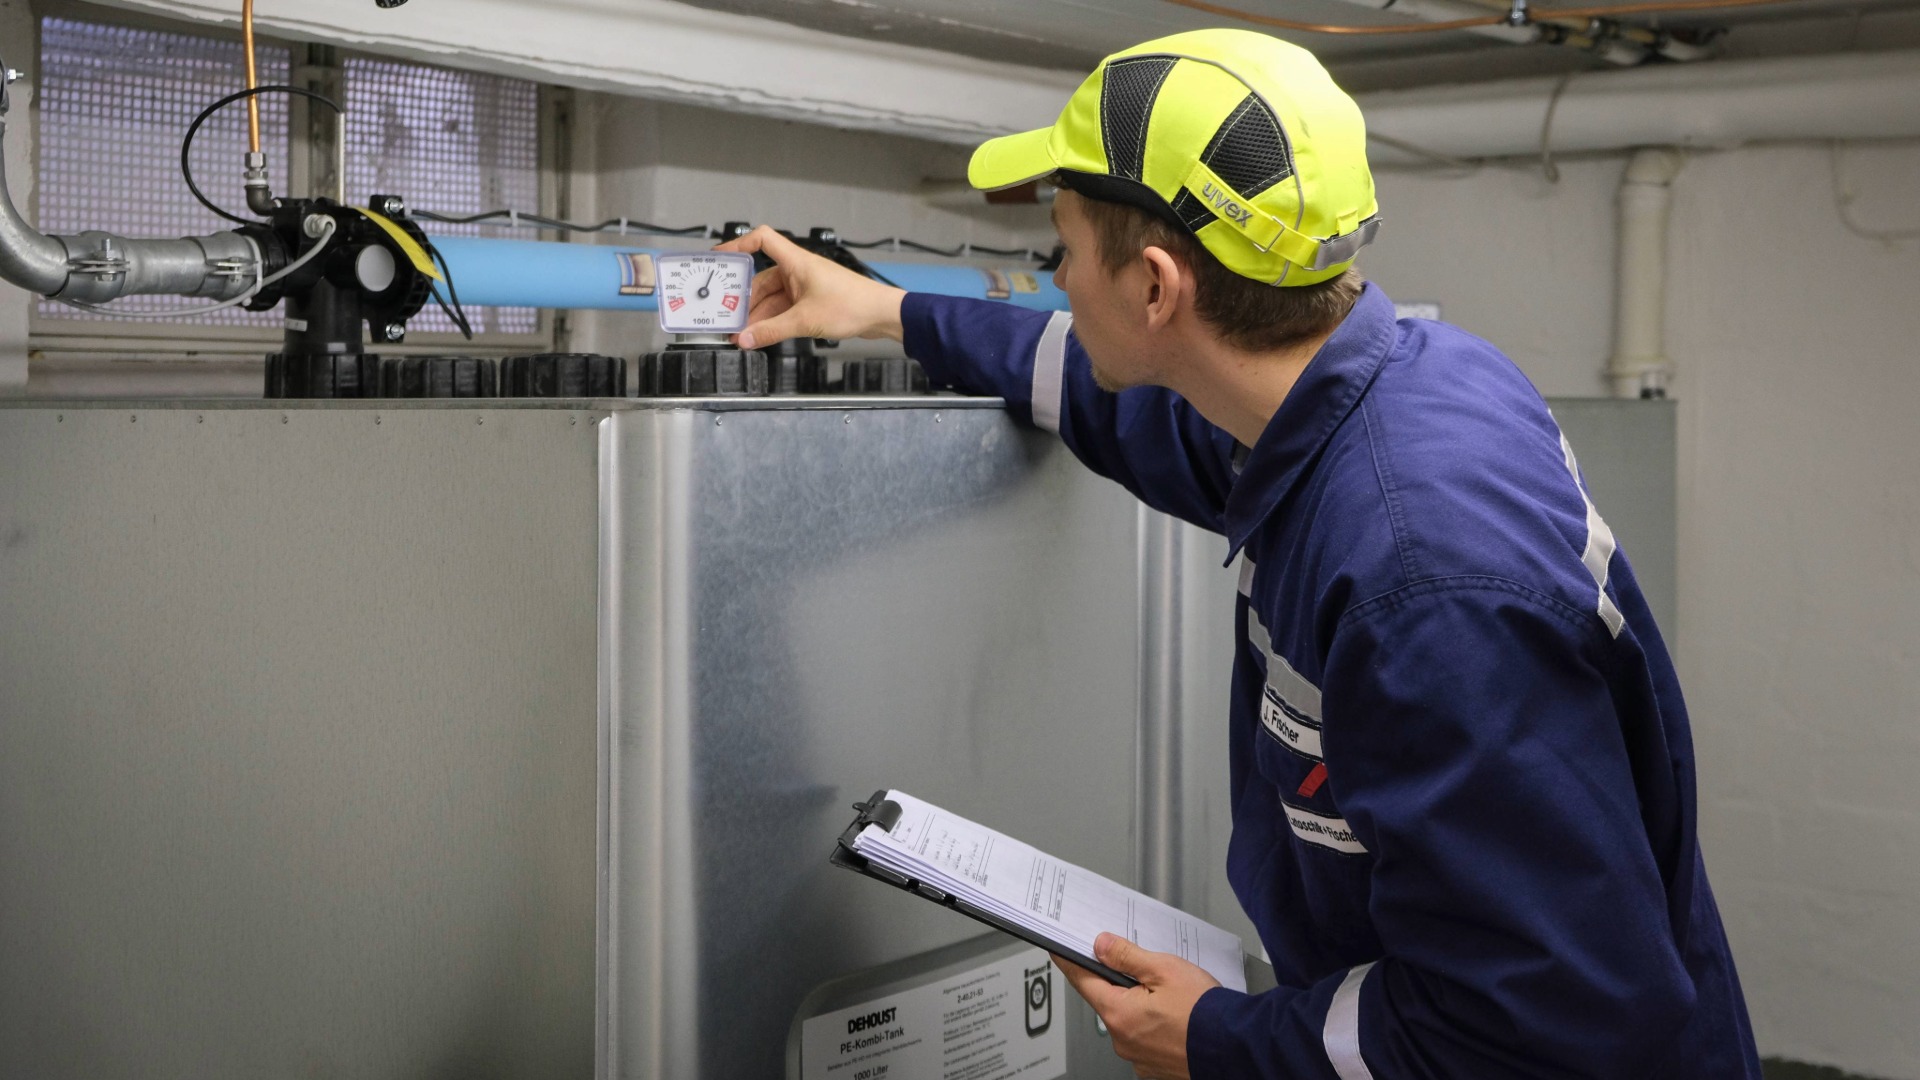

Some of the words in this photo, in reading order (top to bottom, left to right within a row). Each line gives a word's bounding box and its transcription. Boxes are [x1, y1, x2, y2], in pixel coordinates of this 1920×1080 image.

[1202, 181, 1253, 228] uvex
[1263, 704, 1270, 723] J.
[1271, 708, 1299, 744] Fischer
[848, 1006, 897, 1035] DEHOUST
[840, 1025, 904, 1055] PE-Kombi-Tank
[853, 1069, 871, 1080] 1000
[872, 1064, 889, 1077] Liter
